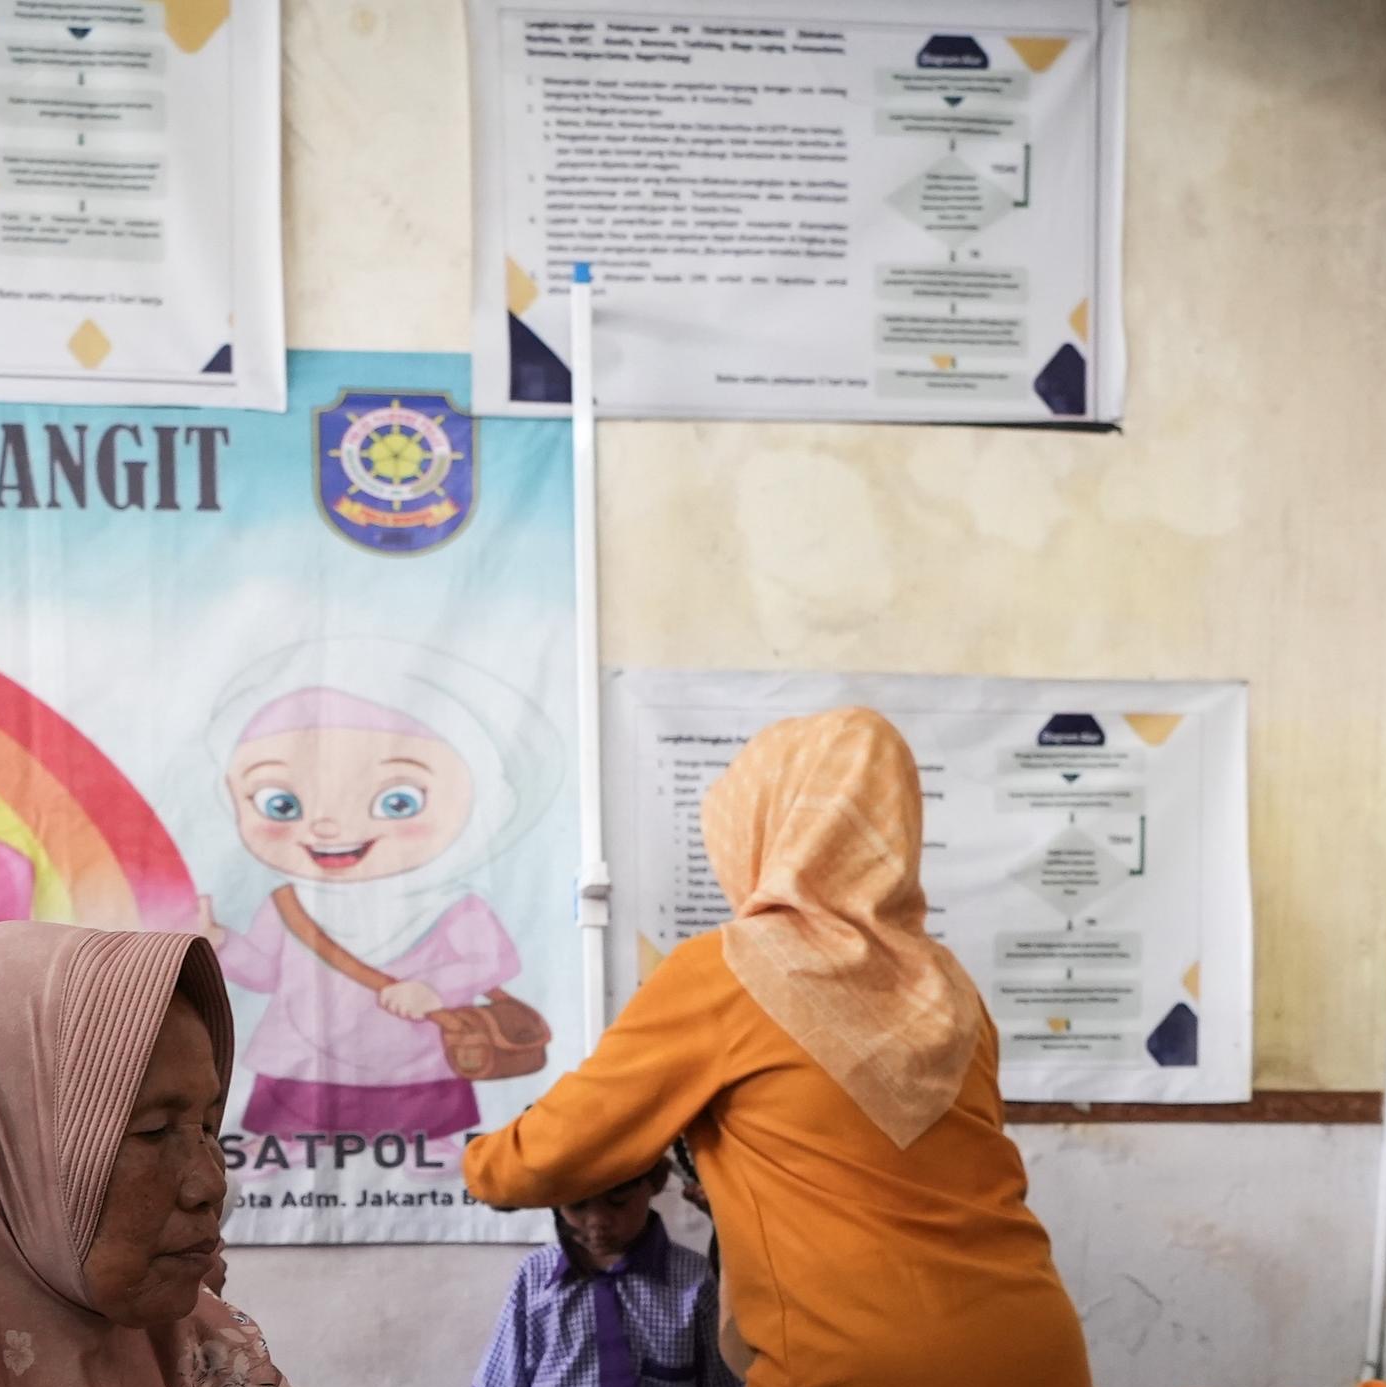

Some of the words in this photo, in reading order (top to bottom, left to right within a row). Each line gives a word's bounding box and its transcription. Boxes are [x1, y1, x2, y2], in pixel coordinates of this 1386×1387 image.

[218, 1133, 445, 1169] SATPOL
[281, 1190, 347, 1209] Adm.
[355, 1189, 454, 1207] Jakarta
